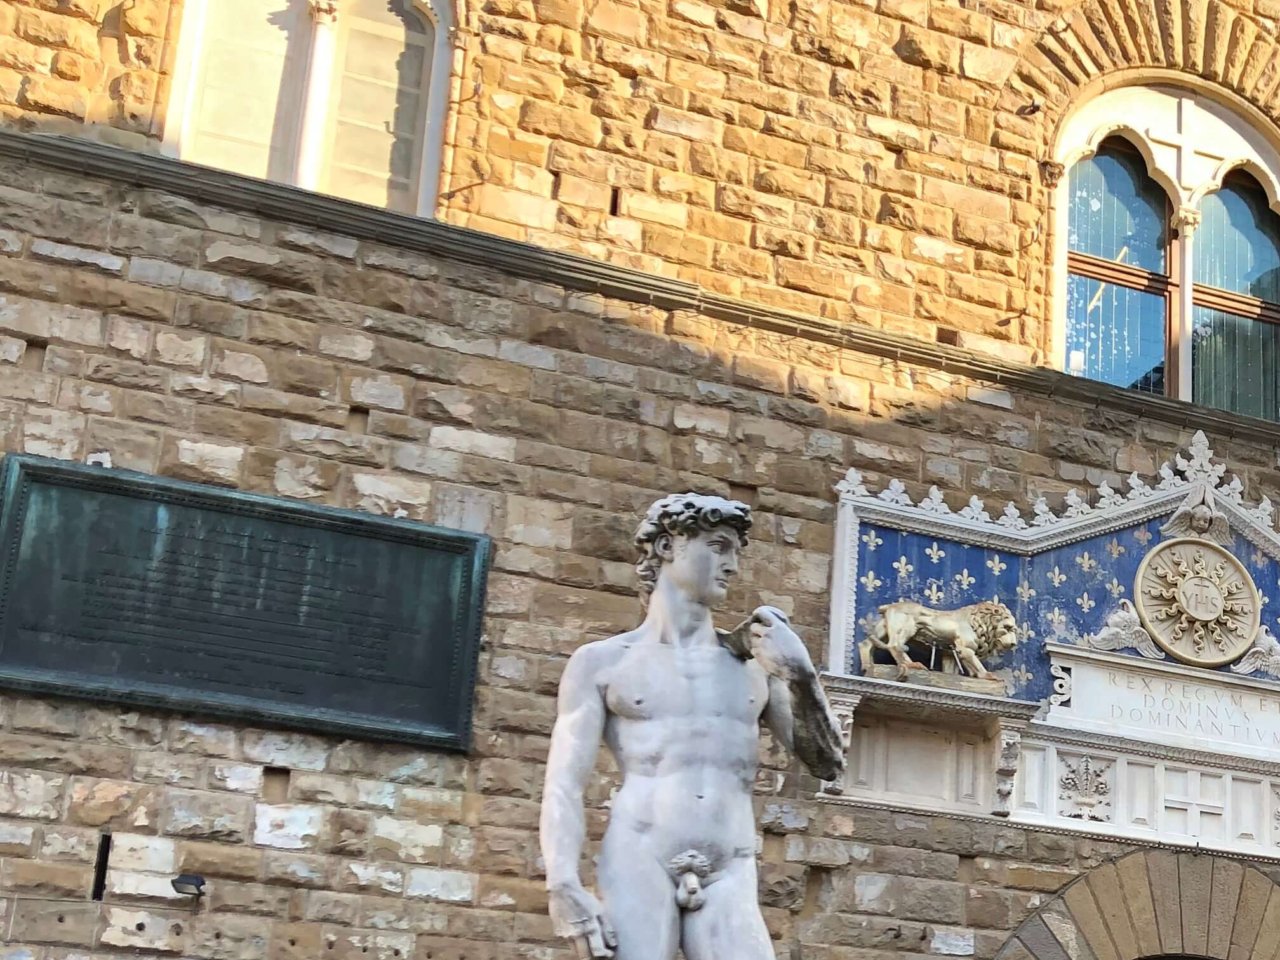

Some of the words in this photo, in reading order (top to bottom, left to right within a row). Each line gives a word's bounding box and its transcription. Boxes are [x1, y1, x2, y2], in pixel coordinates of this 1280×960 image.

[1108, 671, 1153, 693] REX
[1164, 682, 1243, 708] REGVM
[1143, 694, 1251, 723] DOMINVS
